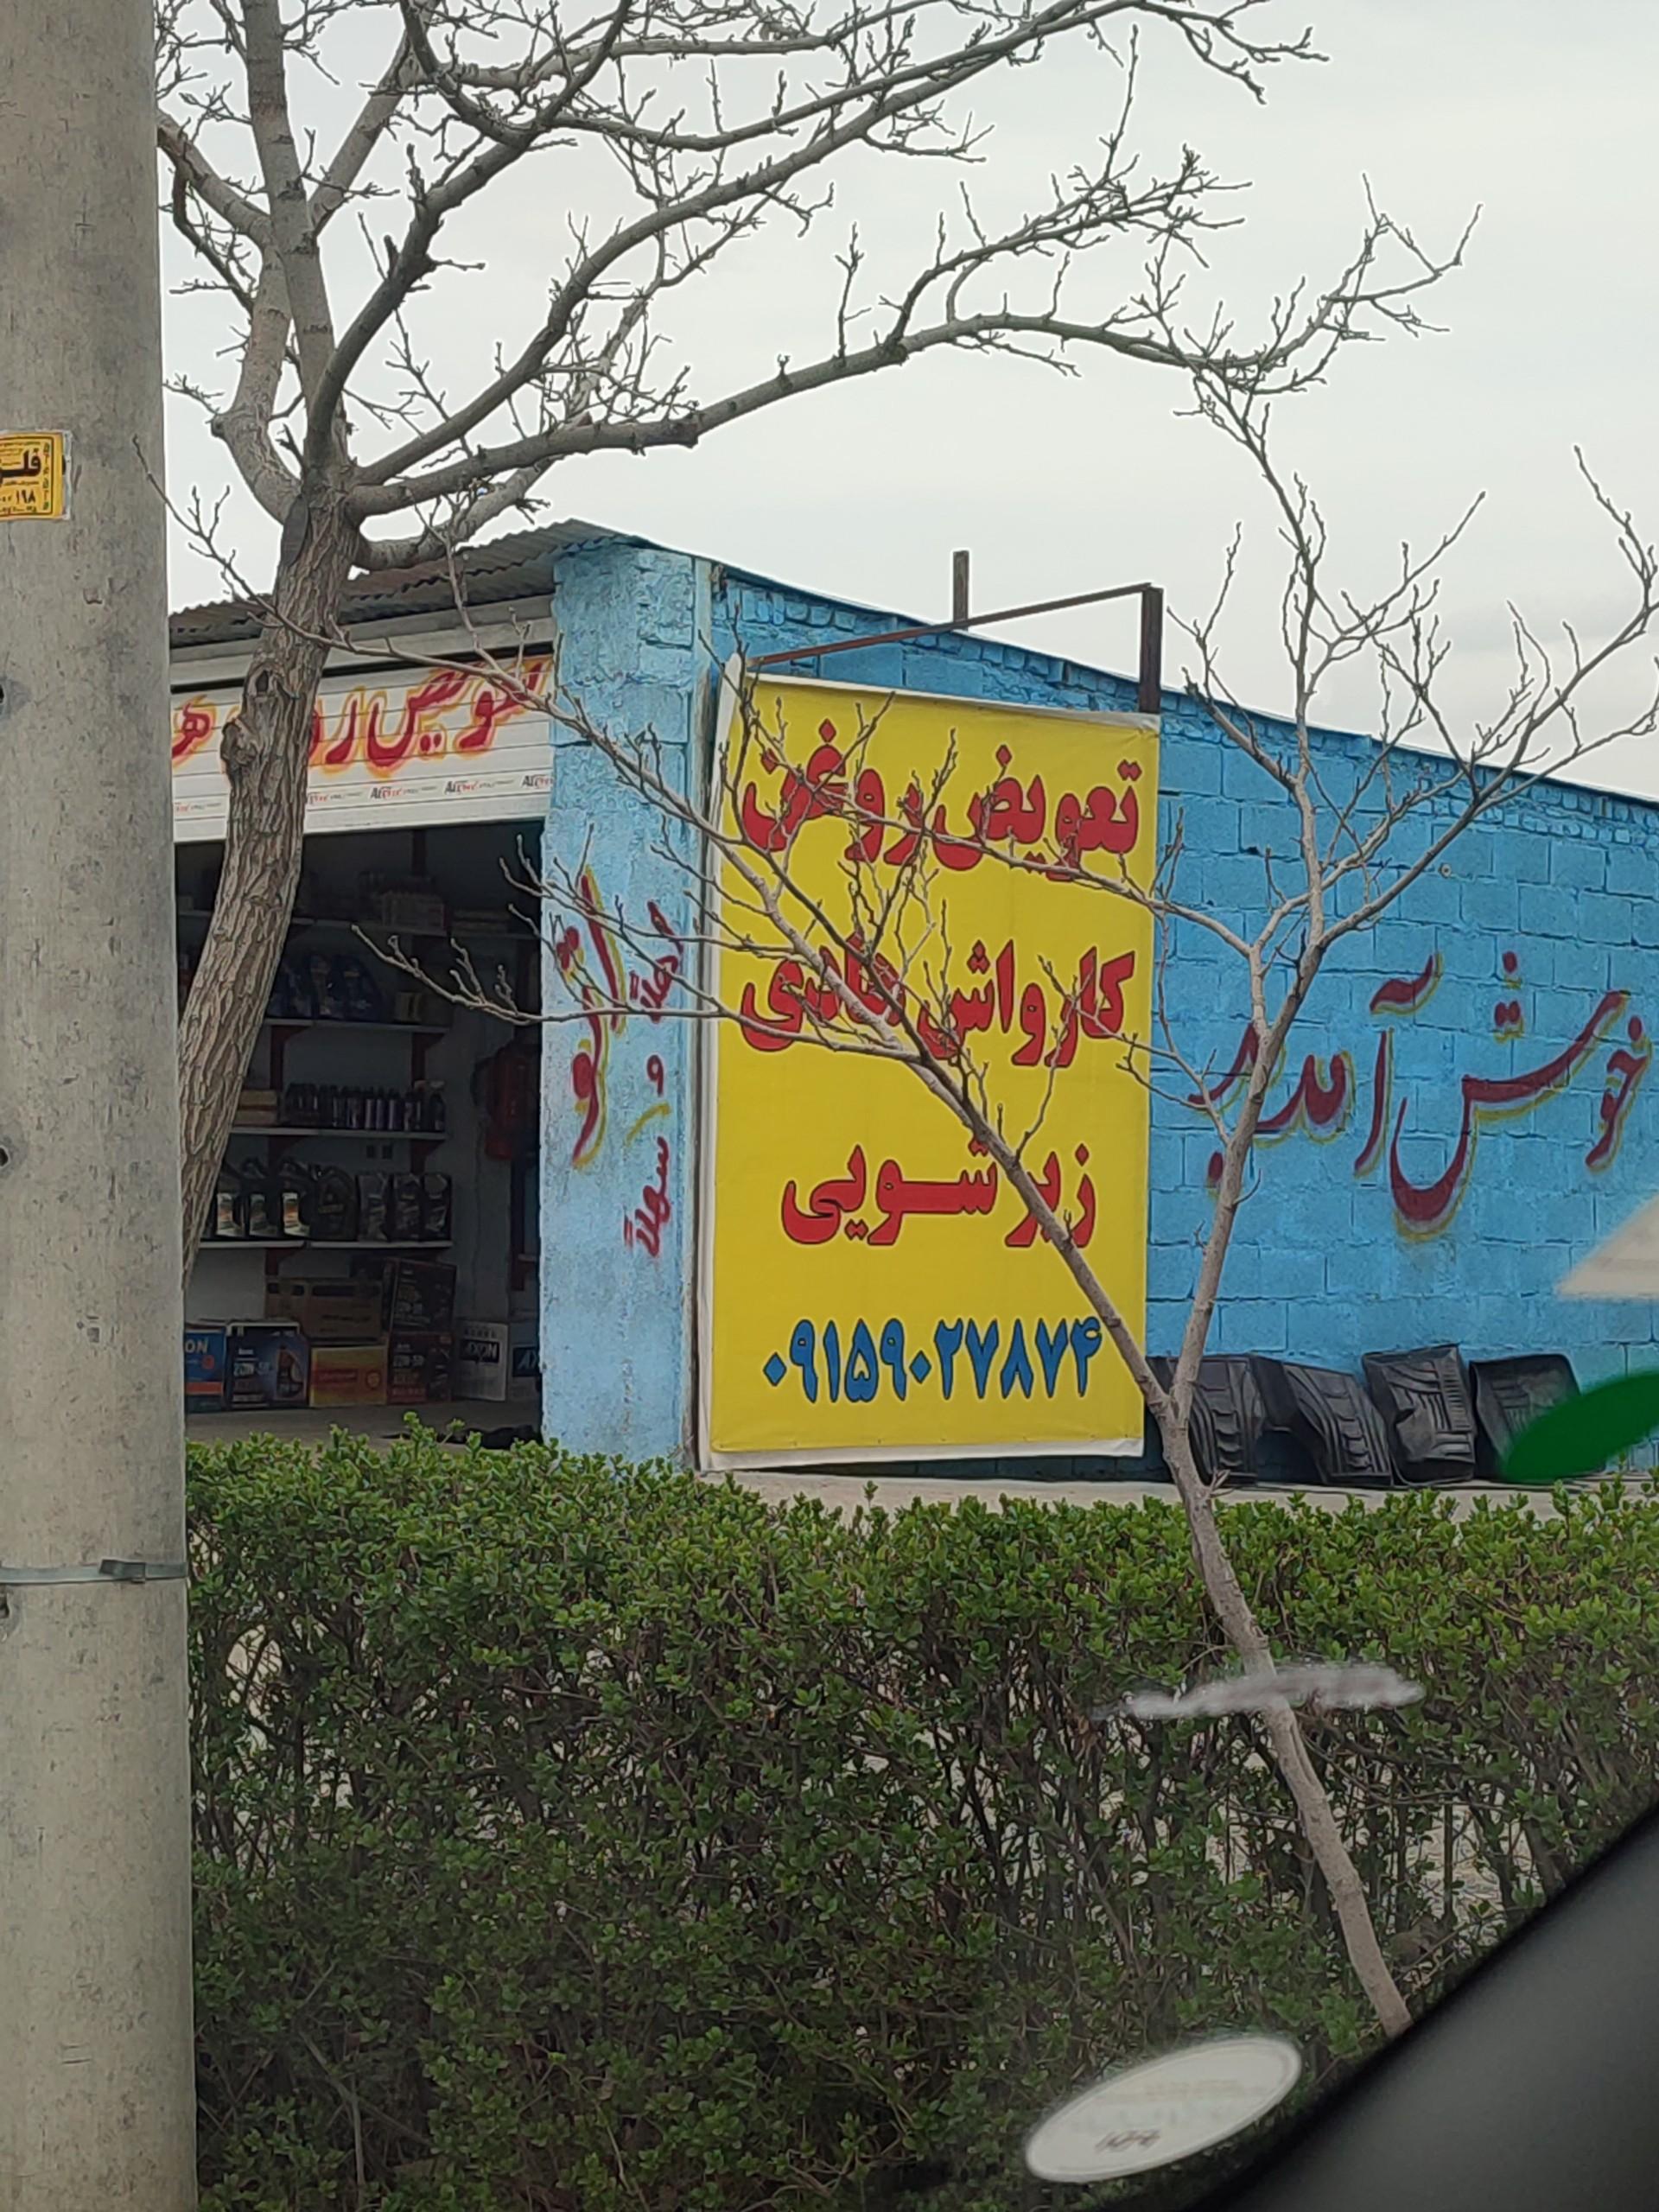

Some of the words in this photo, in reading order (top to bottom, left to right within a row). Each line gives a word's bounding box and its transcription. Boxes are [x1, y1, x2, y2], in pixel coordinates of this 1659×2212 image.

[742, 718, 926, 867] روغن
[932, 745, 1142, 881] تعویض
[917, 938, 1135, 1067] کارواش
[762, 1316, 1103, 1404] ۰۹۱۵۹۰۲۷۸۷۴
